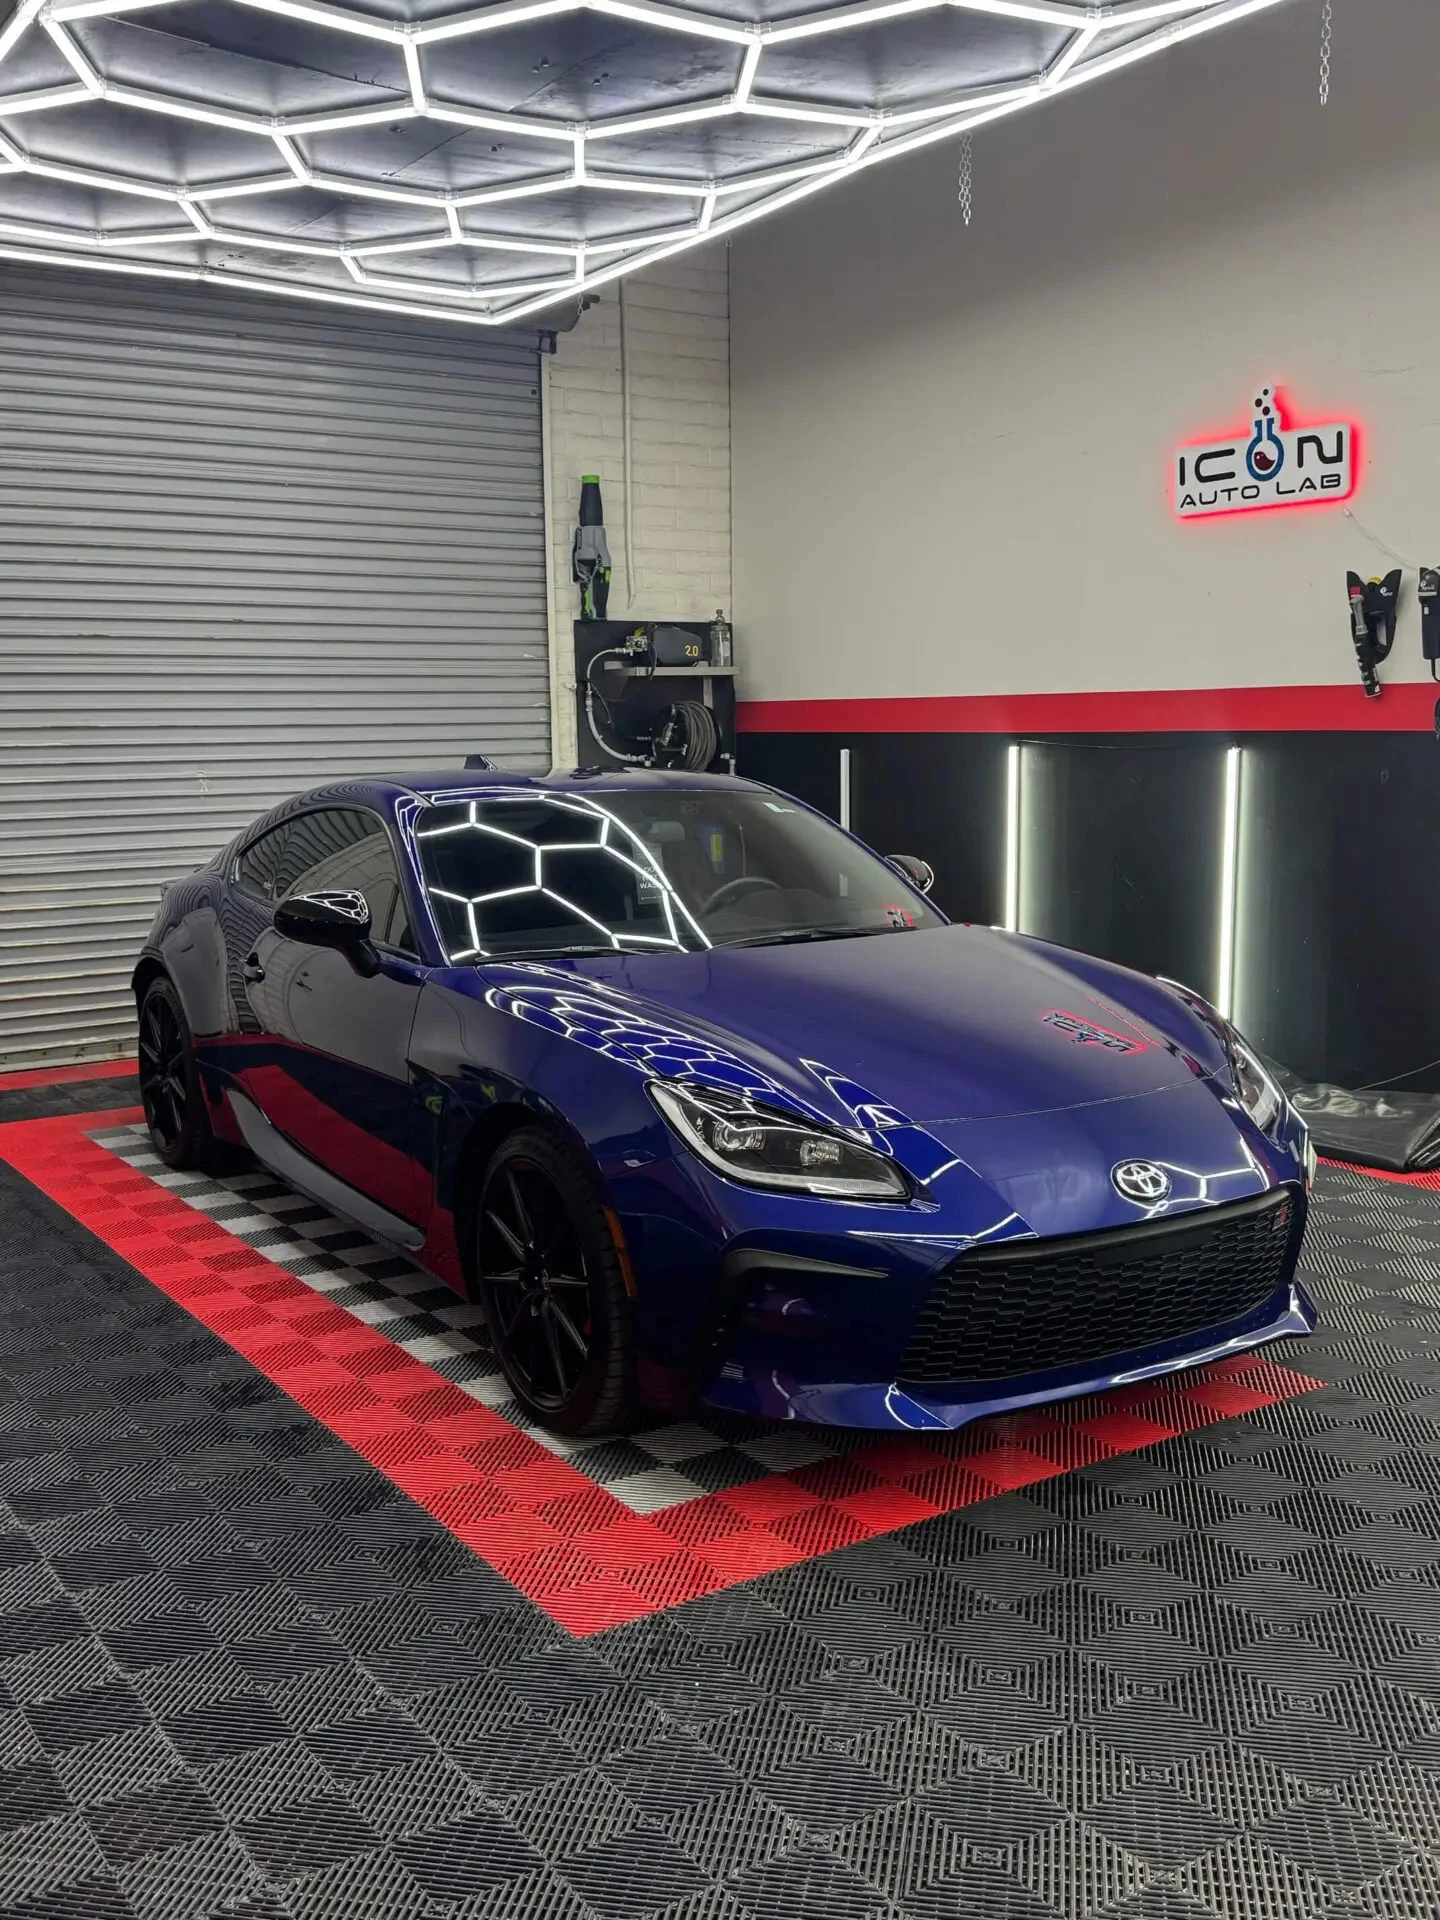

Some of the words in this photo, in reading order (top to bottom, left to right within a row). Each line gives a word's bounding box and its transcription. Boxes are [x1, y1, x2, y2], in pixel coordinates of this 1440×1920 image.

[1179, 418, 1343, 486] ICON
[1180, 484, 1260, 508] AUTO
[1276, 473, 1341, 495] LAB
